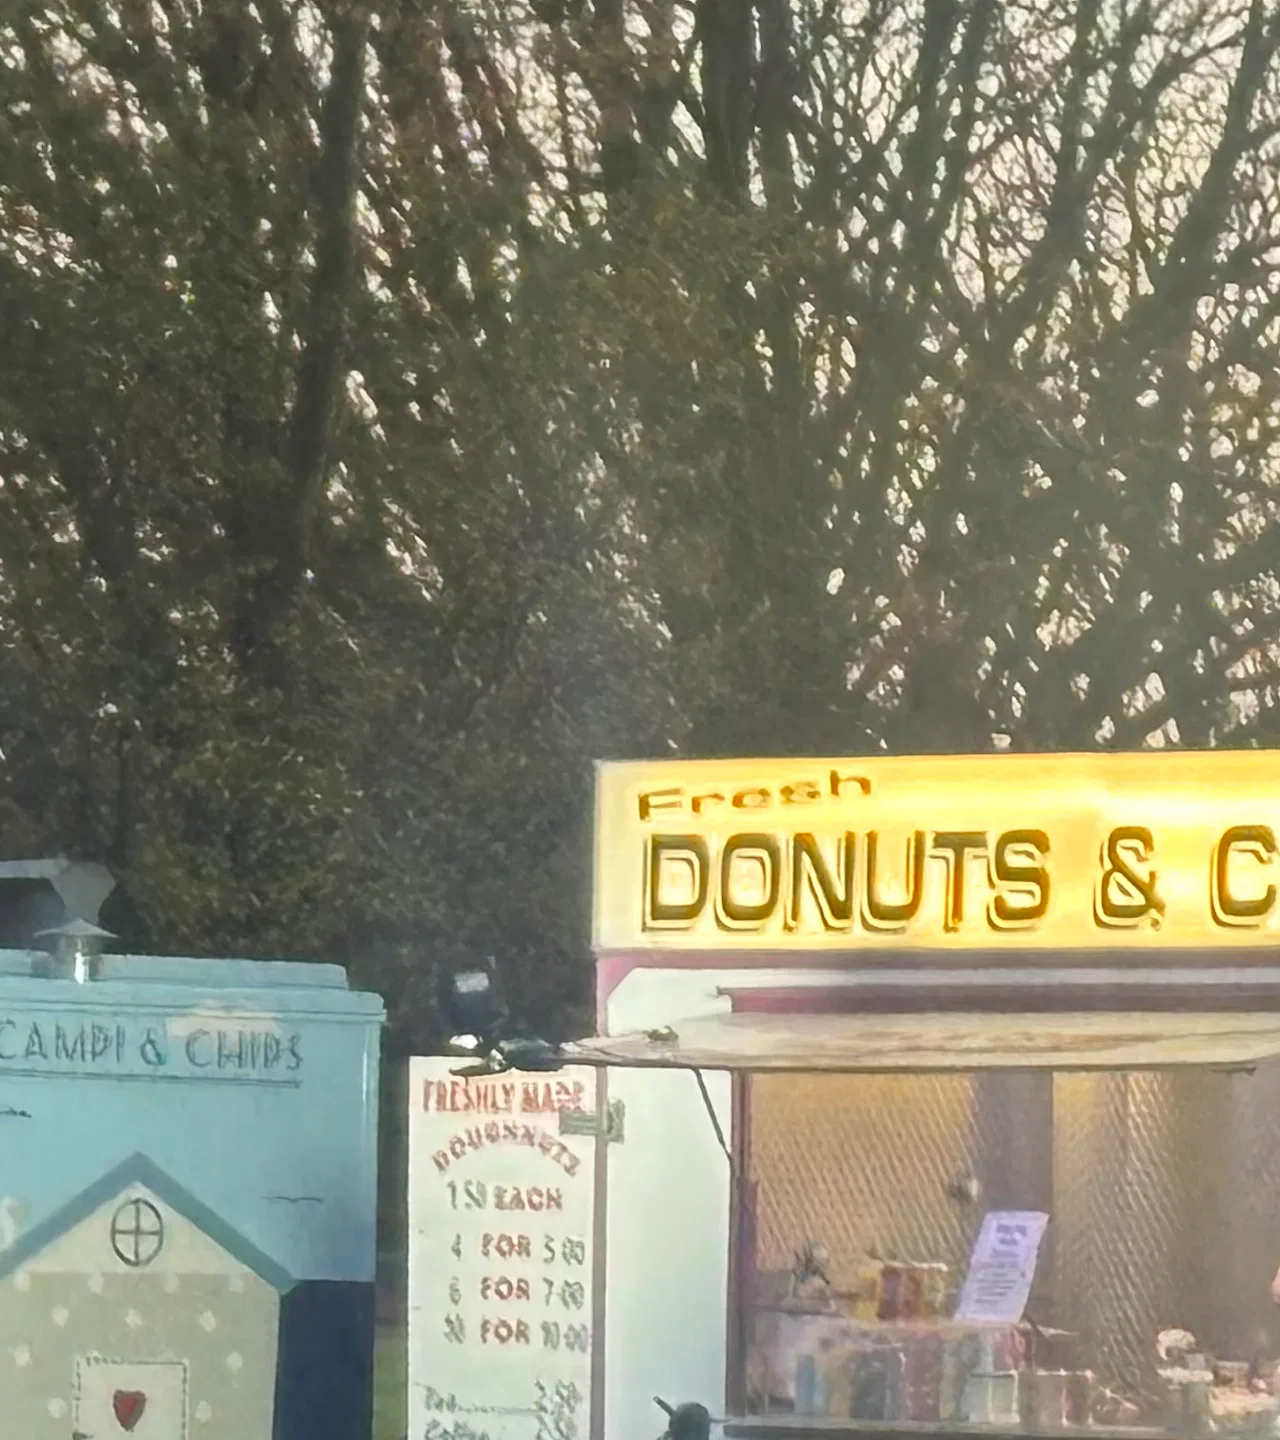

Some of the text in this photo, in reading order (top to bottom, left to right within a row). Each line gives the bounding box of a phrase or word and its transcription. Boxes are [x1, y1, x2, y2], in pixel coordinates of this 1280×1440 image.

[638, 769, 871, 821] Fresh
[641, 828, 1050, 931] DONUTS
[1093, 825, 1166, 931] &
[139, 1022, 168, 1066] &
[185, 1027, 304, 1071] CHIPS
[422, 1078, 515, 1114] FRESHLY
[493, 1184, 564, 1212] EACH
[480, 1232, 532, 1260] FOR
[480, 1275, 531, 1302] FOR
[479, 1314, 531, 1345] FOR
